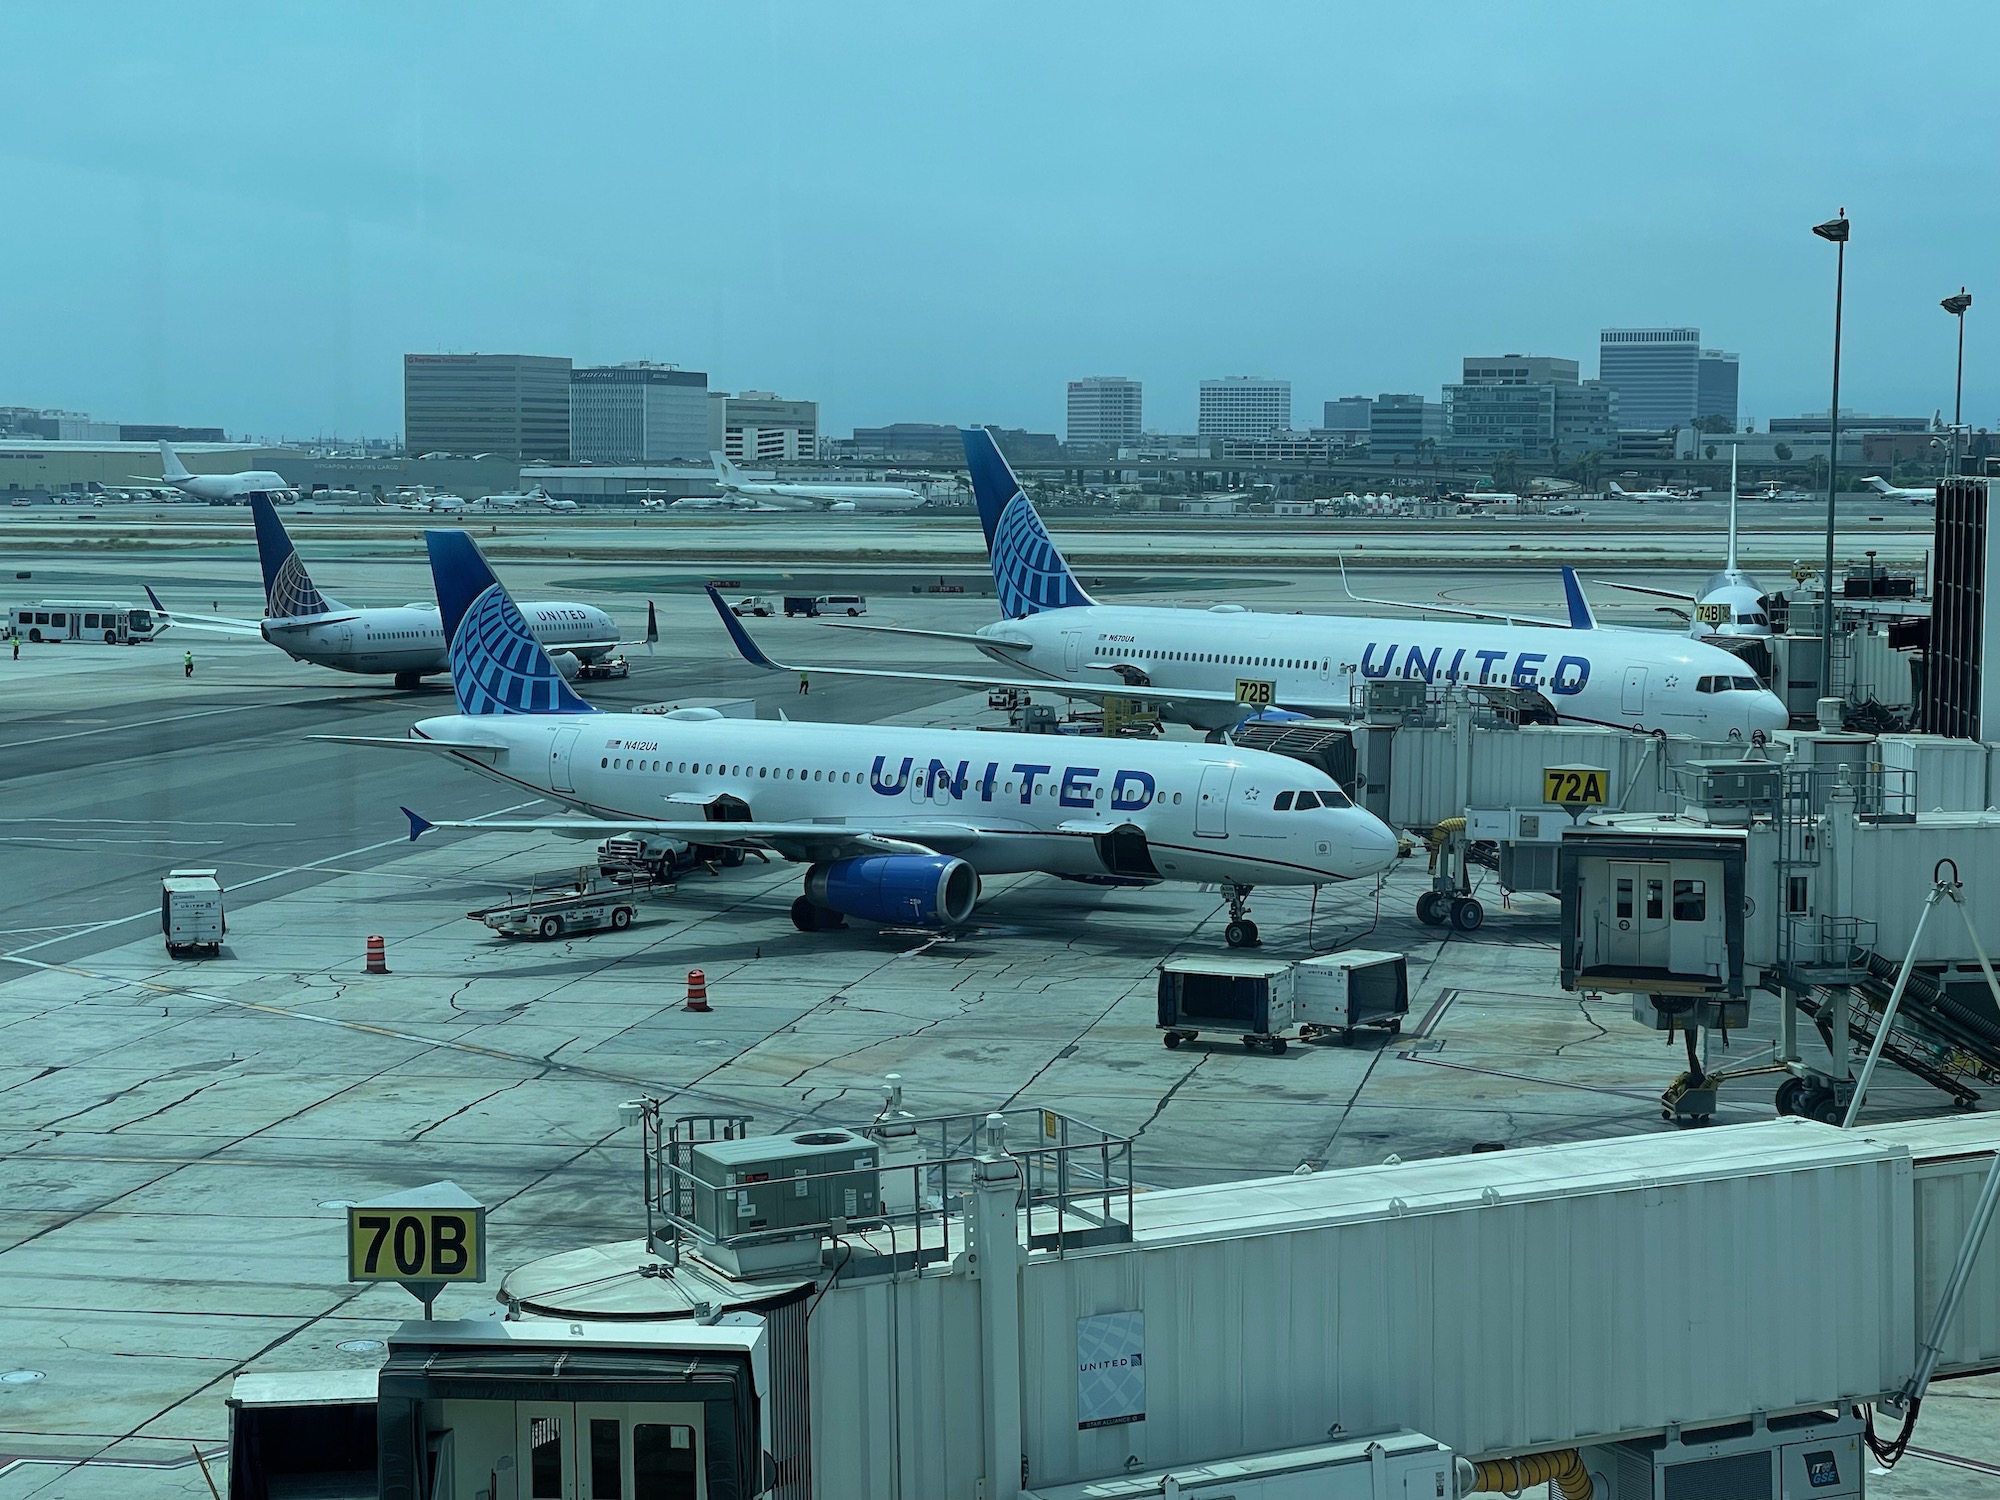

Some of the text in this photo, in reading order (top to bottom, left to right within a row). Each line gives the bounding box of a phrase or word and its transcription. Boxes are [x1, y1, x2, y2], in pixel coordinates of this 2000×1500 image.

[536, 610, 586, 621] UNITED
[1699, 606, 1718, 621] 74B
[1361, 643, 1590, 695] UNITED
[1239, 682, 1270, 703] 72B
[624, 741, 658, 751] N412UA
[870, 756, 1155, 811] UNITED
[1549, 773, 1602, 802] 72A
[359, 1216, 468, 1275] 70B
[1080, 1359, 1128, 1371] UNITED
[1102, 1416, 1131, 1426] ALLIANCE
[1813, 1471, 1836, 1484] GSE
